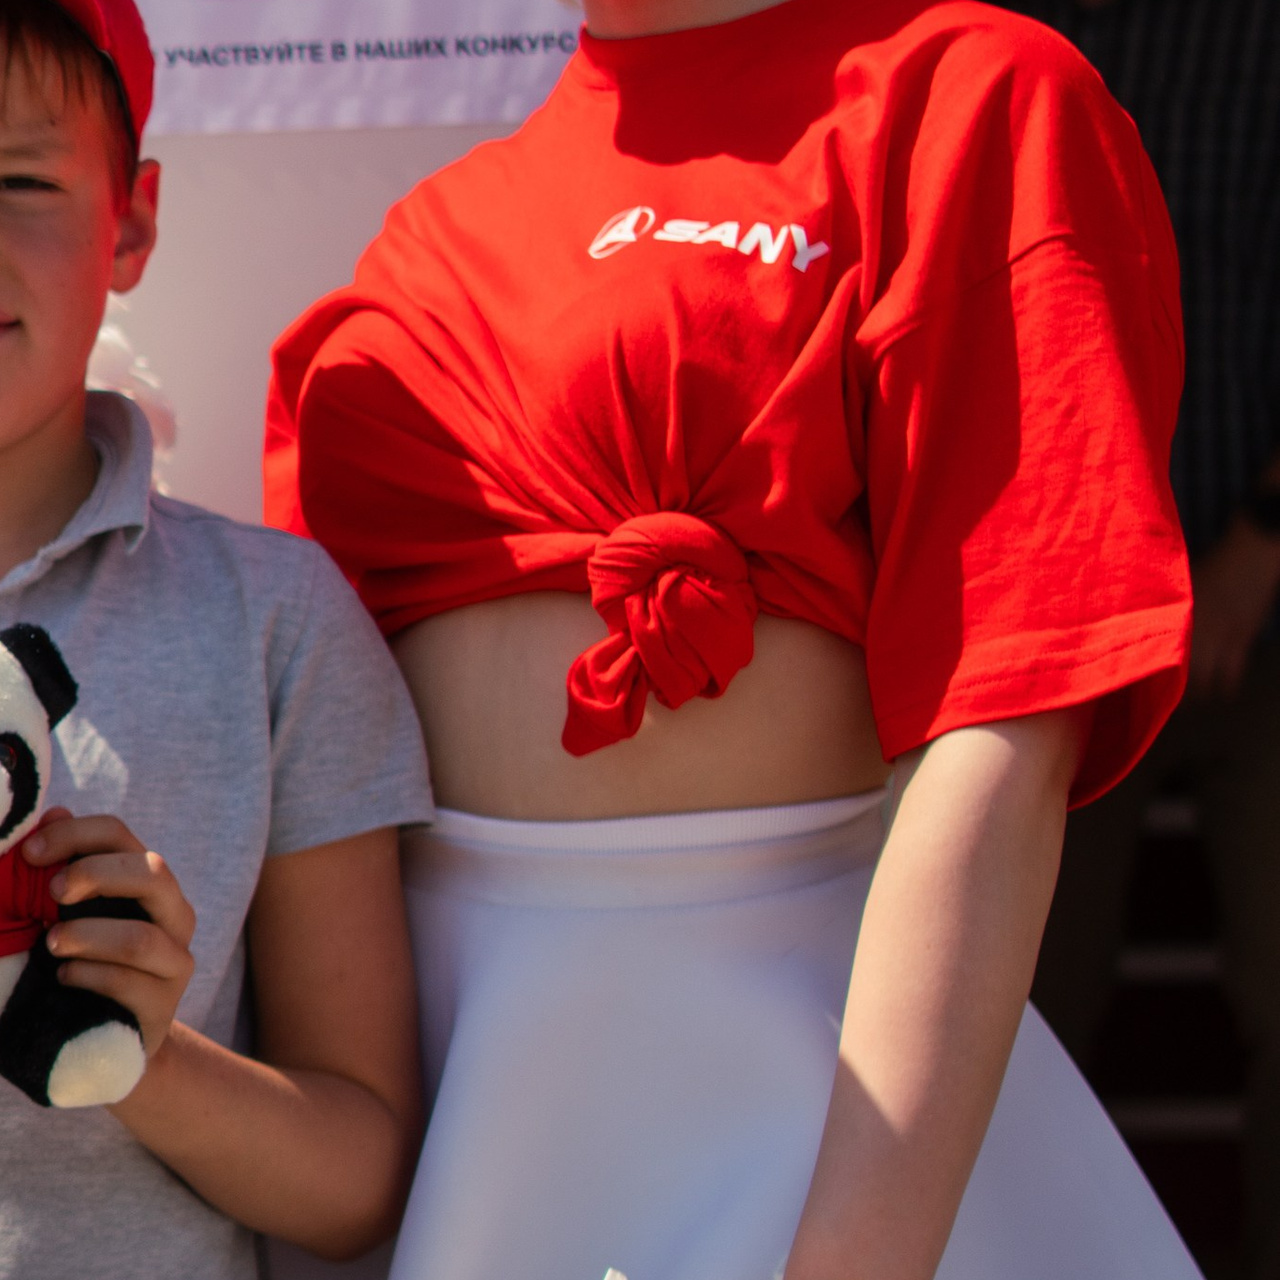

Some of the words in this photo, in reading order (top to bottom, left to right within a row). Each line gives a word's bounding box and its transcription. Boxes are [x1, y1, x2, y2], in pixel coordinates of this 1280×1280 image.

[164, 41, 323, 68] УЧАСТВУЙТЕ
[331, 42, 347, 61] В
[354, 37, 447, 61] НАШИХ
[455, 32, 578, 57] КОНКУРС
[653, 219, 830, 273] SANY
